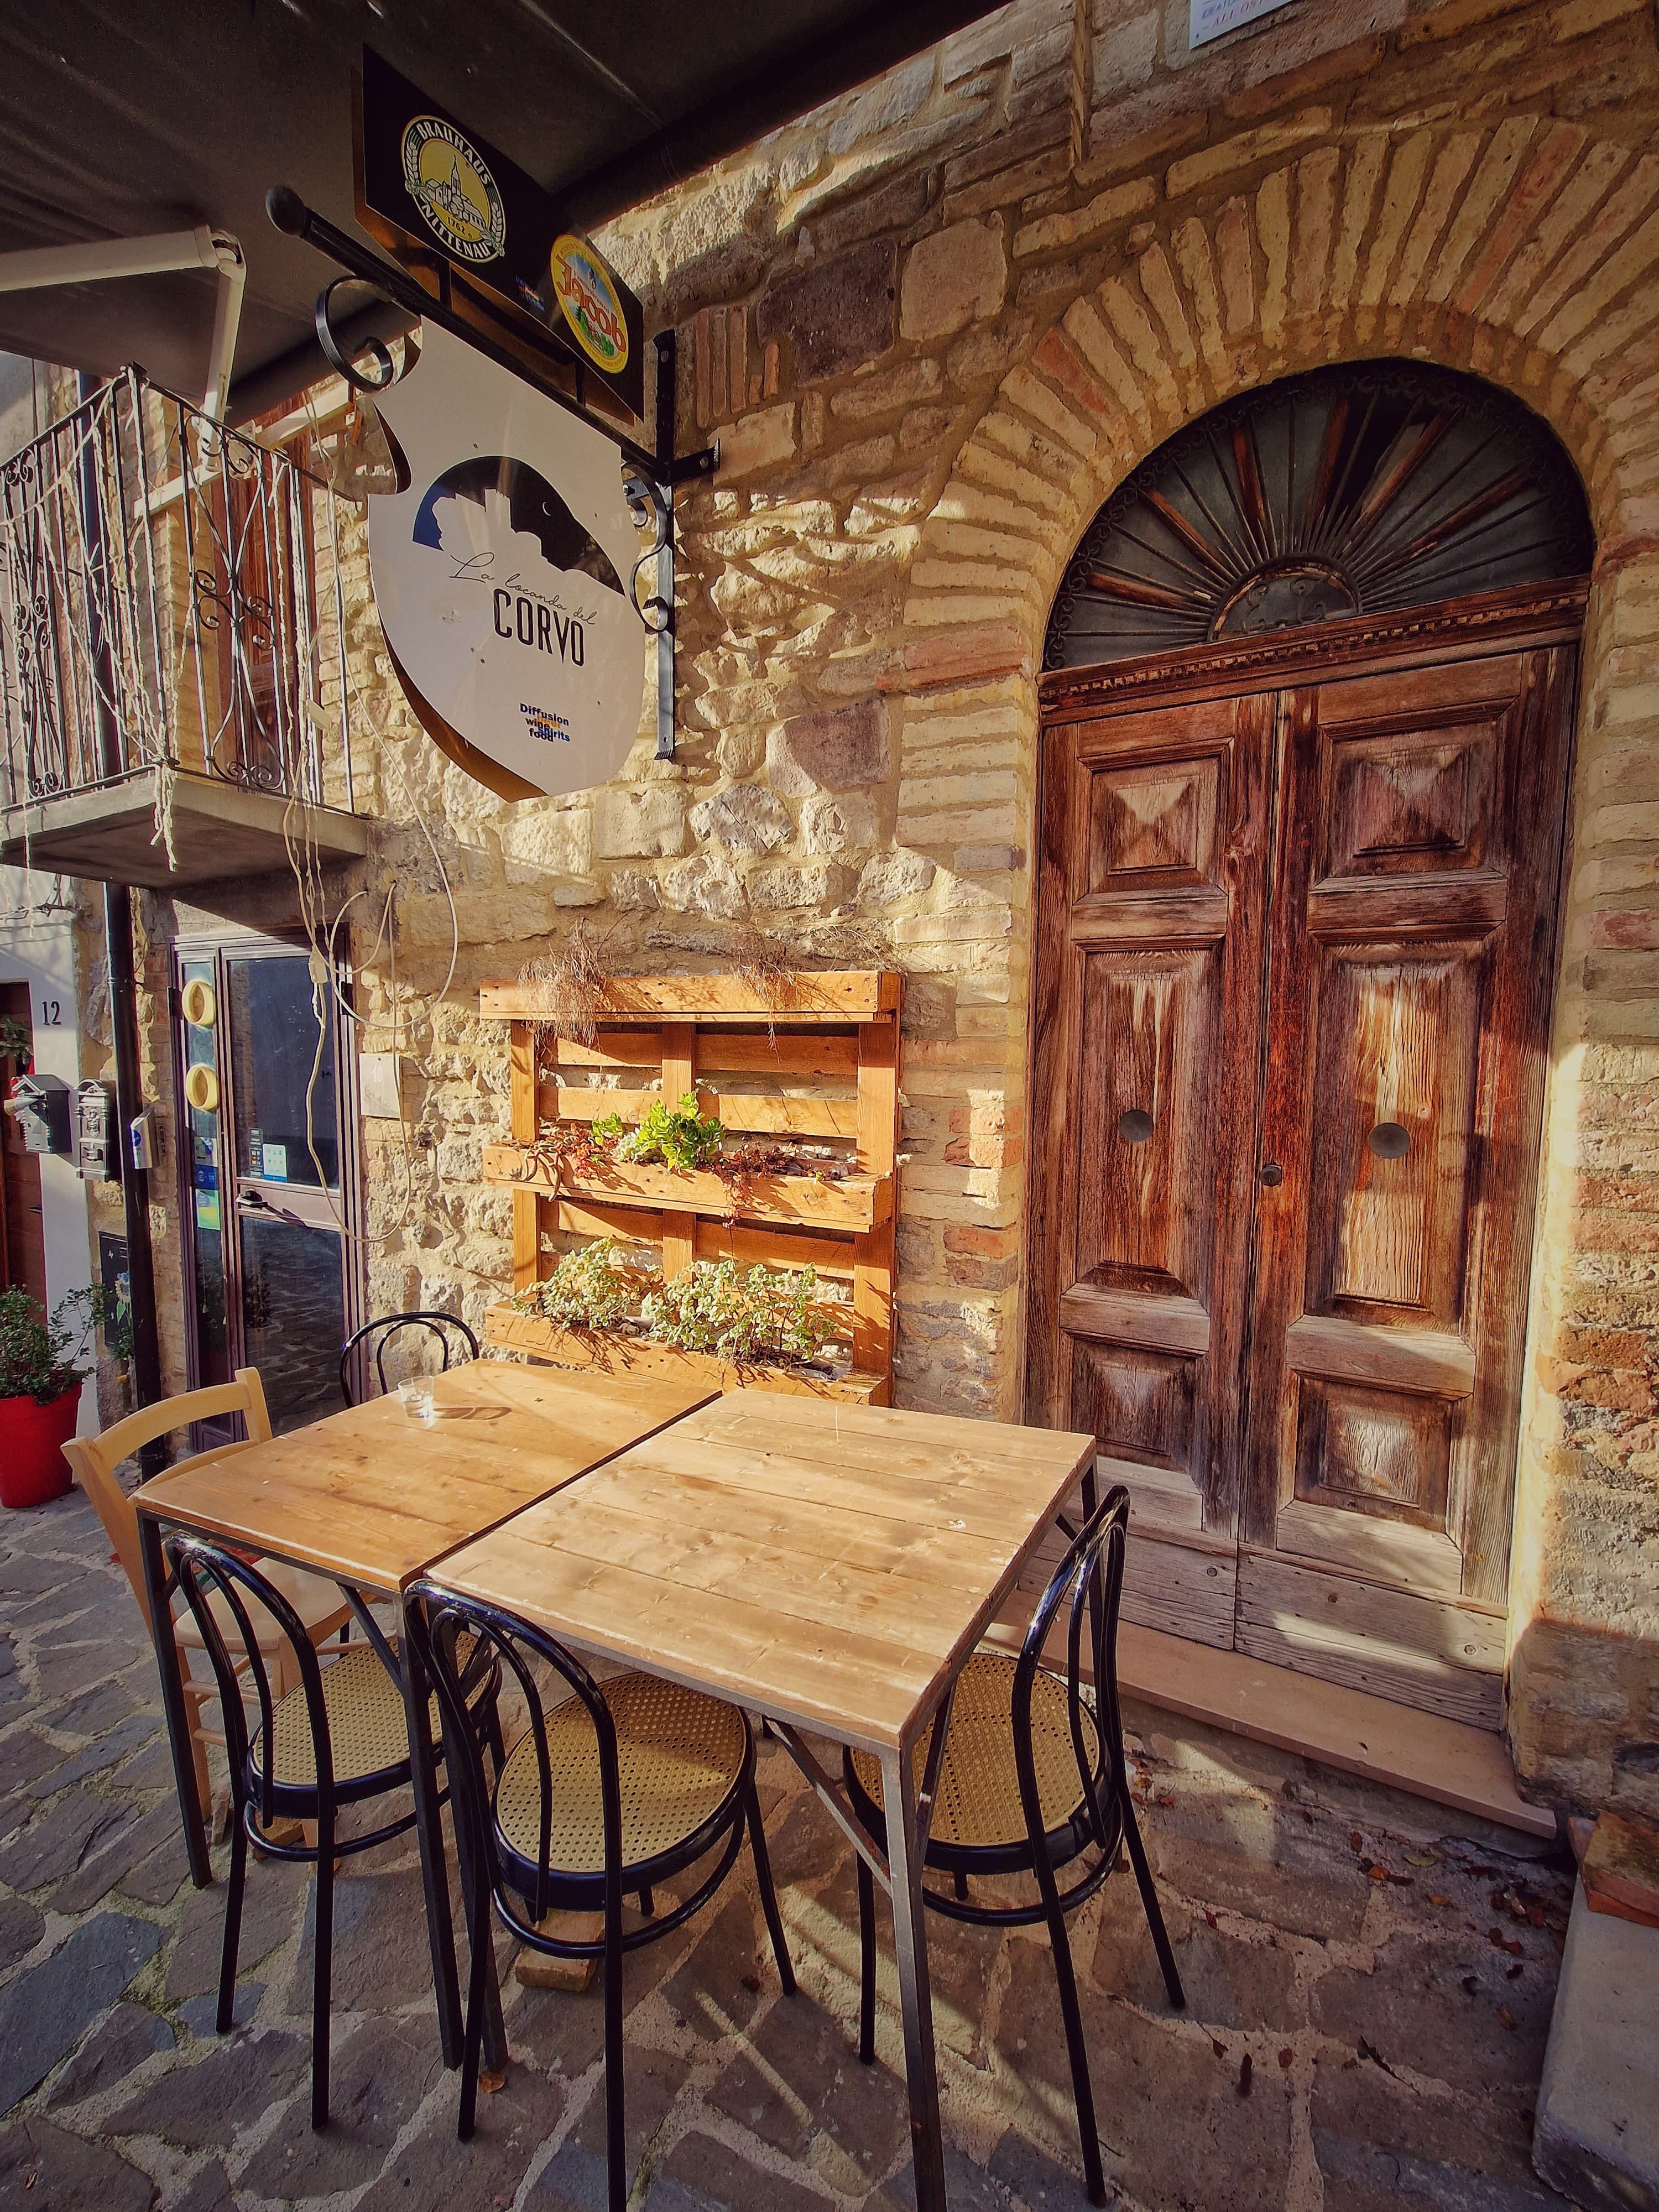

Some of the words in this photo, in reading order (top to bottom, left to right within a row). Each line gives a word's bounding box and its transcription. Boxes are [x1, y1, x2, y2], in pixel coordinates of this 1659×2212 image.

[416, 121, 491, 185] BRAUHAUS
[422, 204, 491, 258] NITTENAU
[447, 216, 466, 235] 1762
[555, 254, 626, 353] Jacob
[449, 552, 495, 583] La
[504, 573, 567, 611] locanda
[573, 607, 597, 625] del
[493, 588, 584, 667] CORVO
[520, 703, 569, 726] Diffusion
[525, 718, 550, 729] wine
[529, 728, 554, 742] food
[41, 1000, 61, 1025] 12
[371, 1065, 382, 1083] 10
